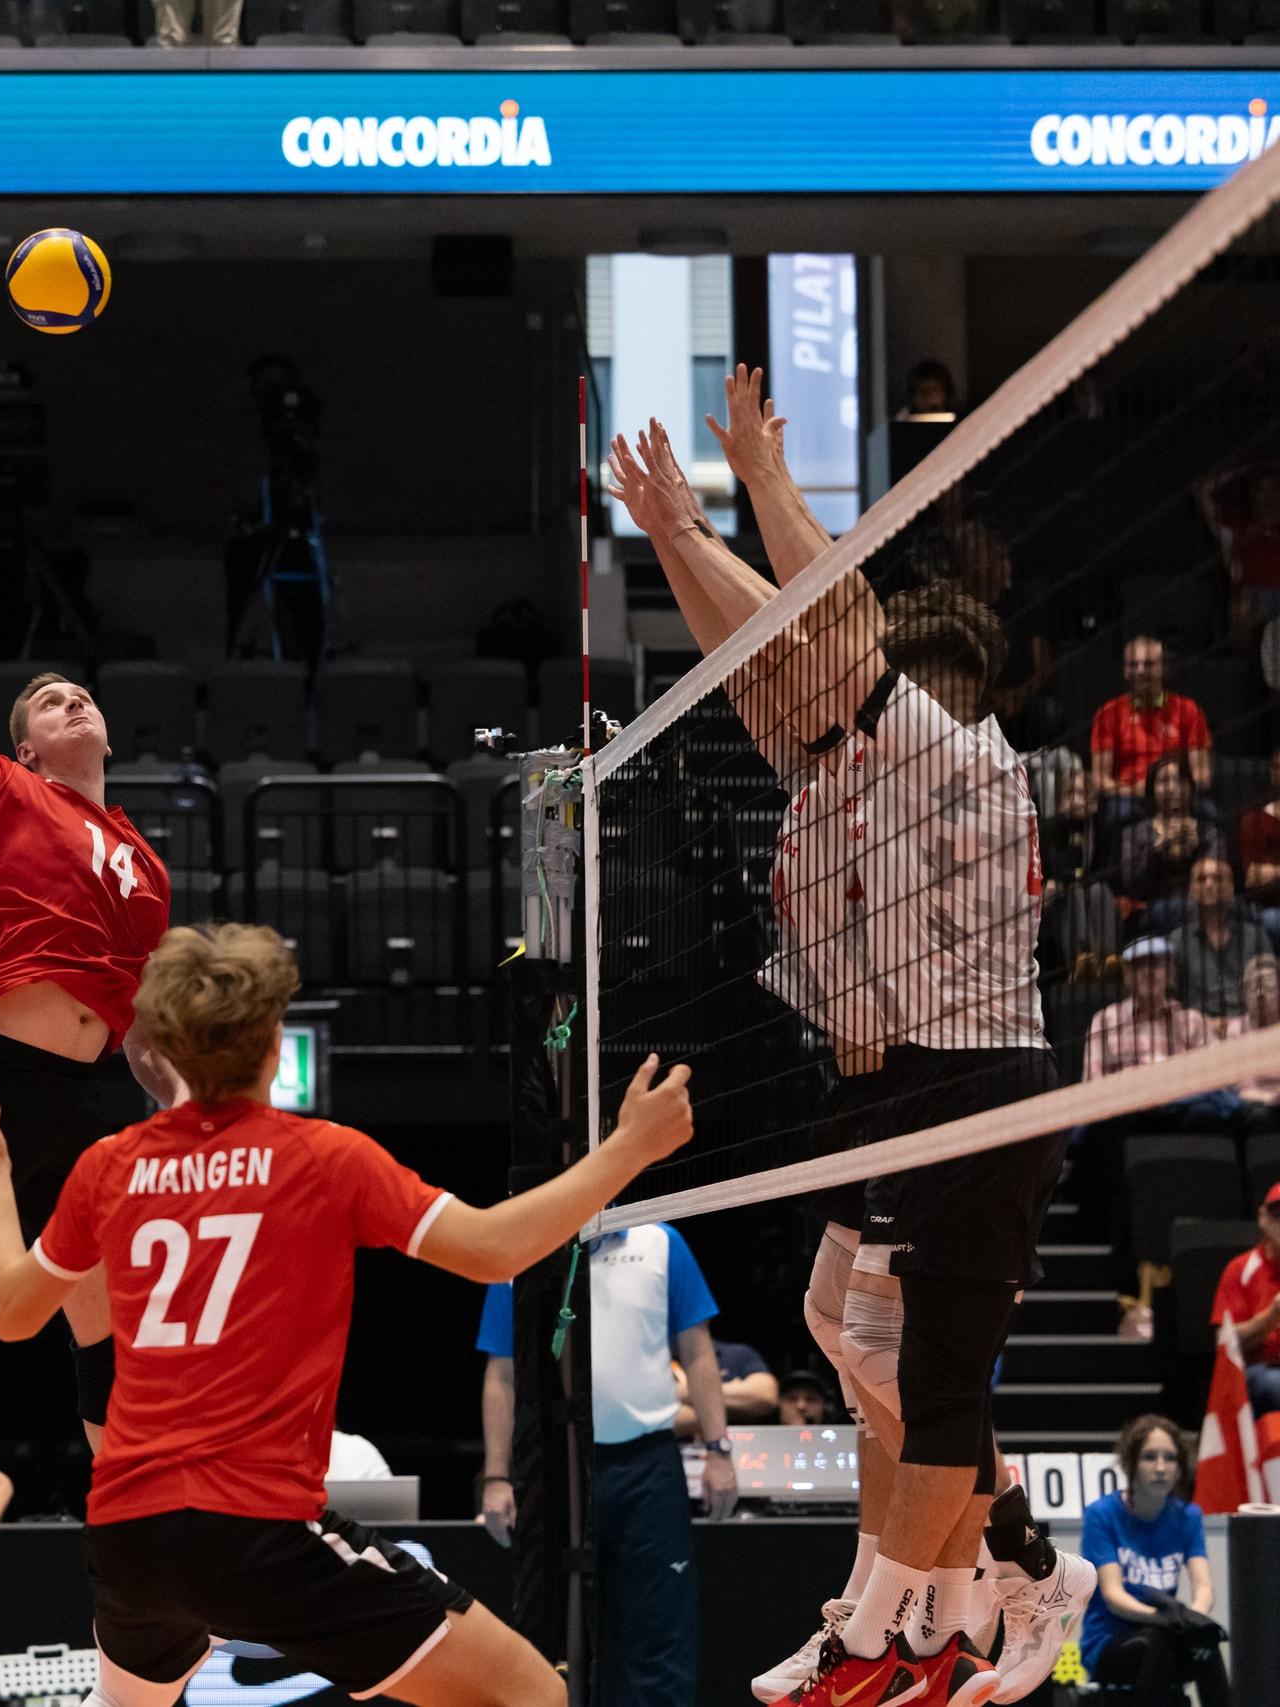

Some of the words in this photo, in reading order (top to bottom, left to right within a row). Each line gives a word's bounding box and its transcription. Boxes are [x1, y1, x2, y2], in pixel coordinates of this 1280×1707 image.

[281, 98, 553, 167] CONCORDIA
[793, 253, 834, 374] PILAT
[84, 819, 139, 900] 14
[127, 1146, 274, 1196] MANGEN
[869, 1215, 895, 1224] CRAF
[130, 1211, 264, 1349] 27
[892, 1588, 914, 1628] CRAFT
[925, 1584, 935, 1624] CRAFT
